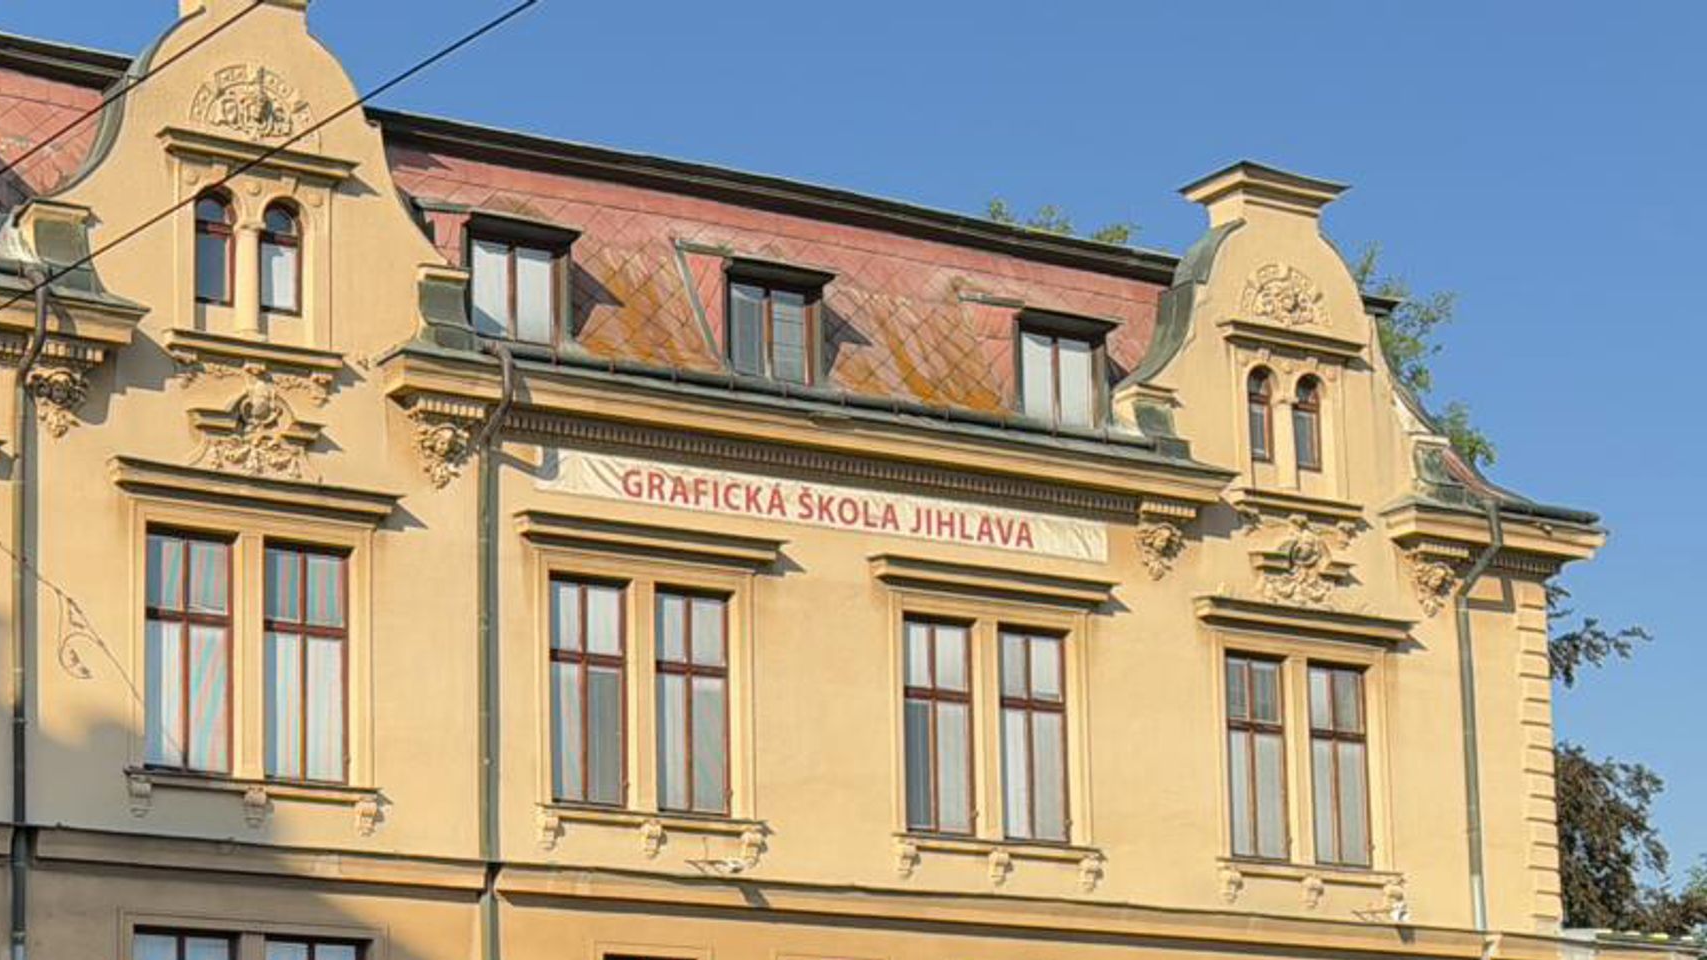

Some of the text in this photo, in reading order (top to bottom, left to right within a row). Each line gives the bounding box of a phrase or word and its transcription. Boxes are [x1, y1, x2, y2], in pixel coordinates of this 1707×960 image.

[622, 469, 1034, 549] GRAFICKÁ ŠKOLA JIHLAVA
